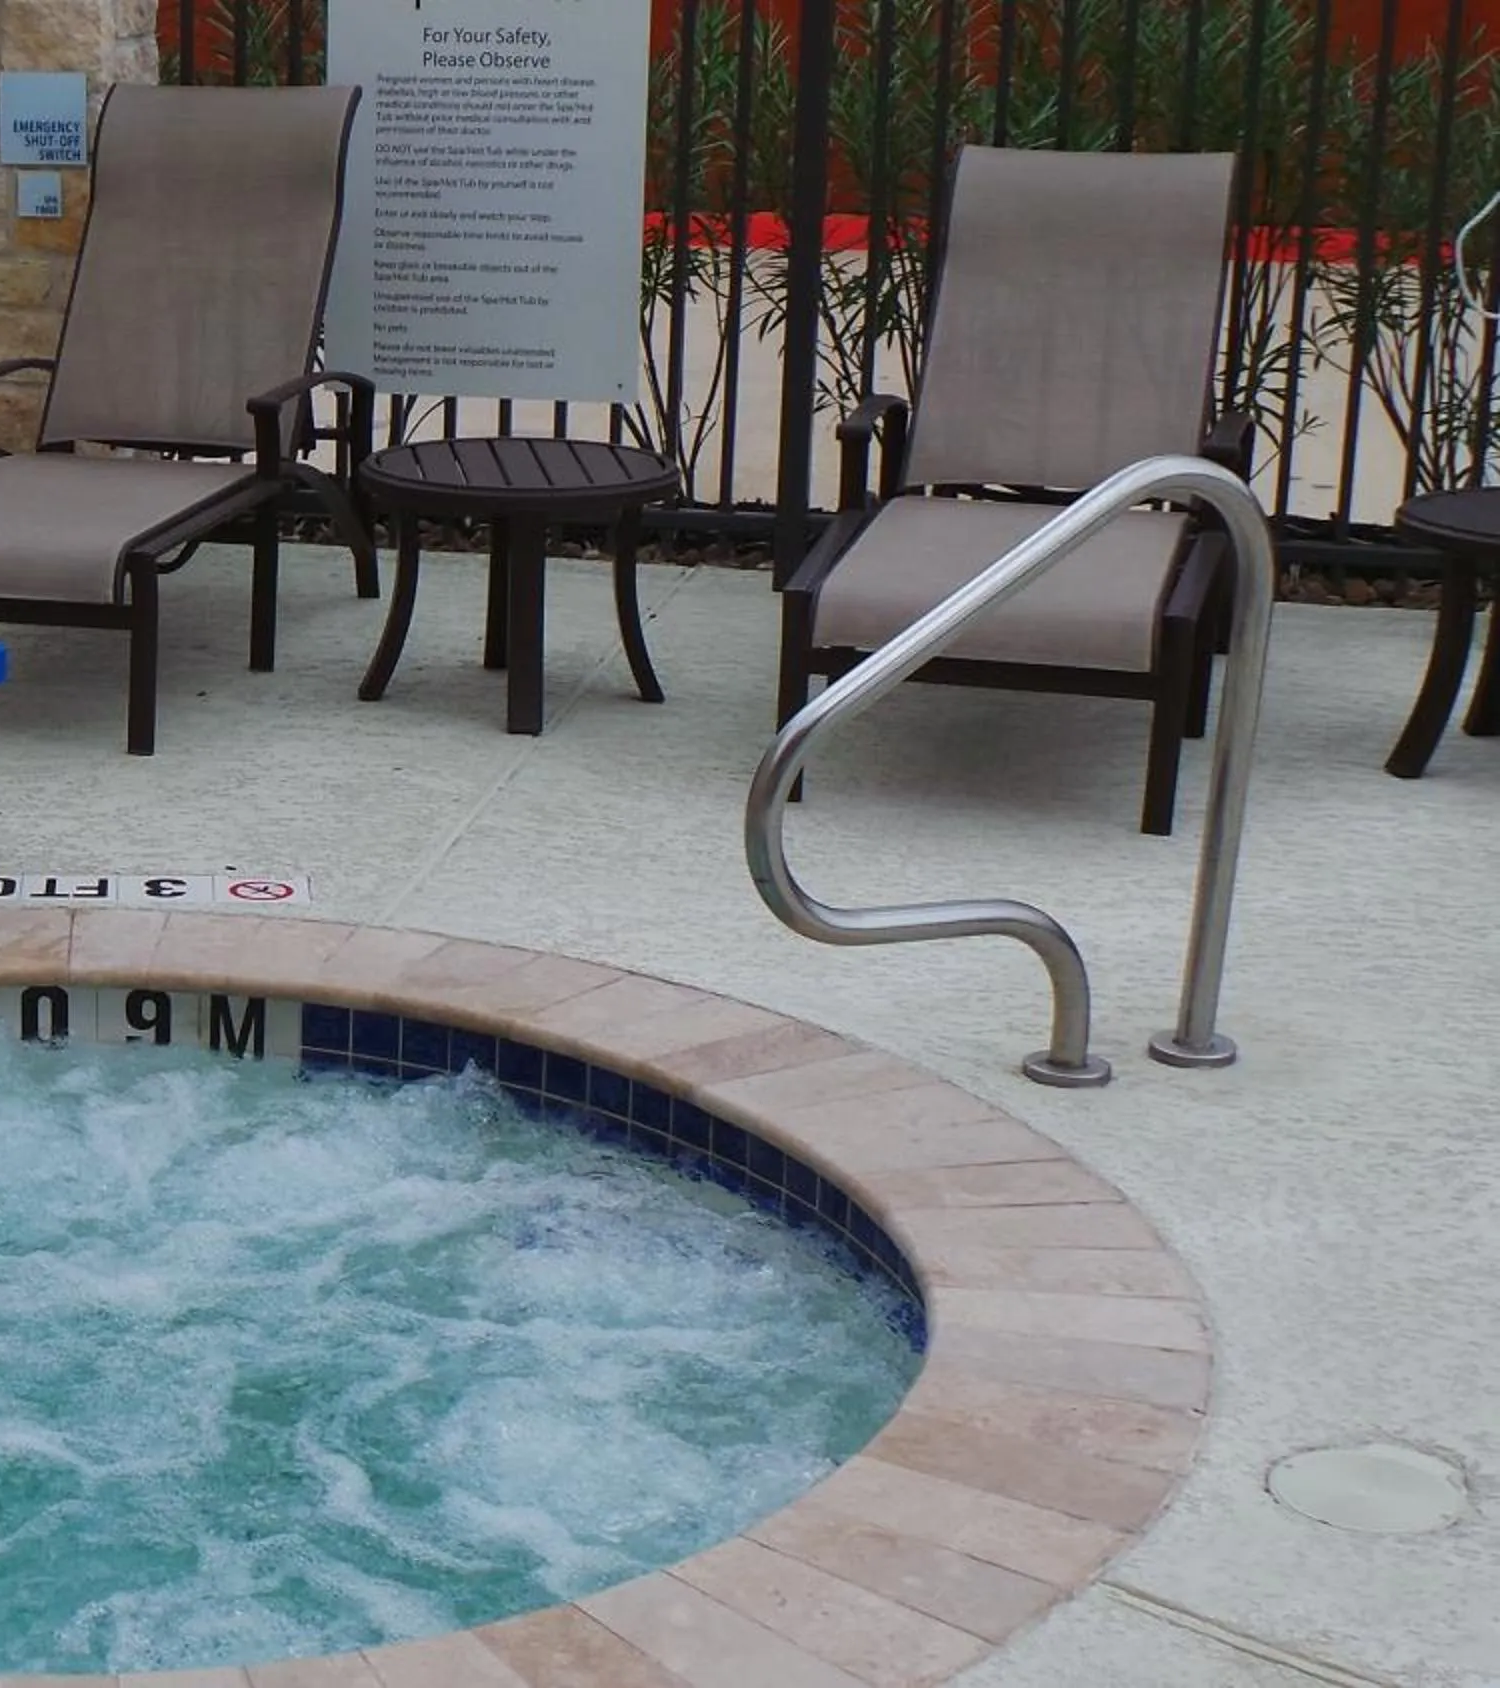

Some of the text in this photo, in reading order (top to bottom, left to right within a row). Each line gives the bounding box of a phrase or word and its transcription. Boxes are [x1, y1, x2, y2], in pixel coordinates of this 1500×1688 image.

[423, 27, 551, 48] For Your Safety,
[423, 52, 551, 69] Please Observe
[13, 119, 80, 133] EMERGENCY
[24, 135, 81, 147] SHUT-OFF
[39, 150, 81, 161] SWITCH
[144, 878, 187, 897] 3
[209, 993, 266, 1061] M
